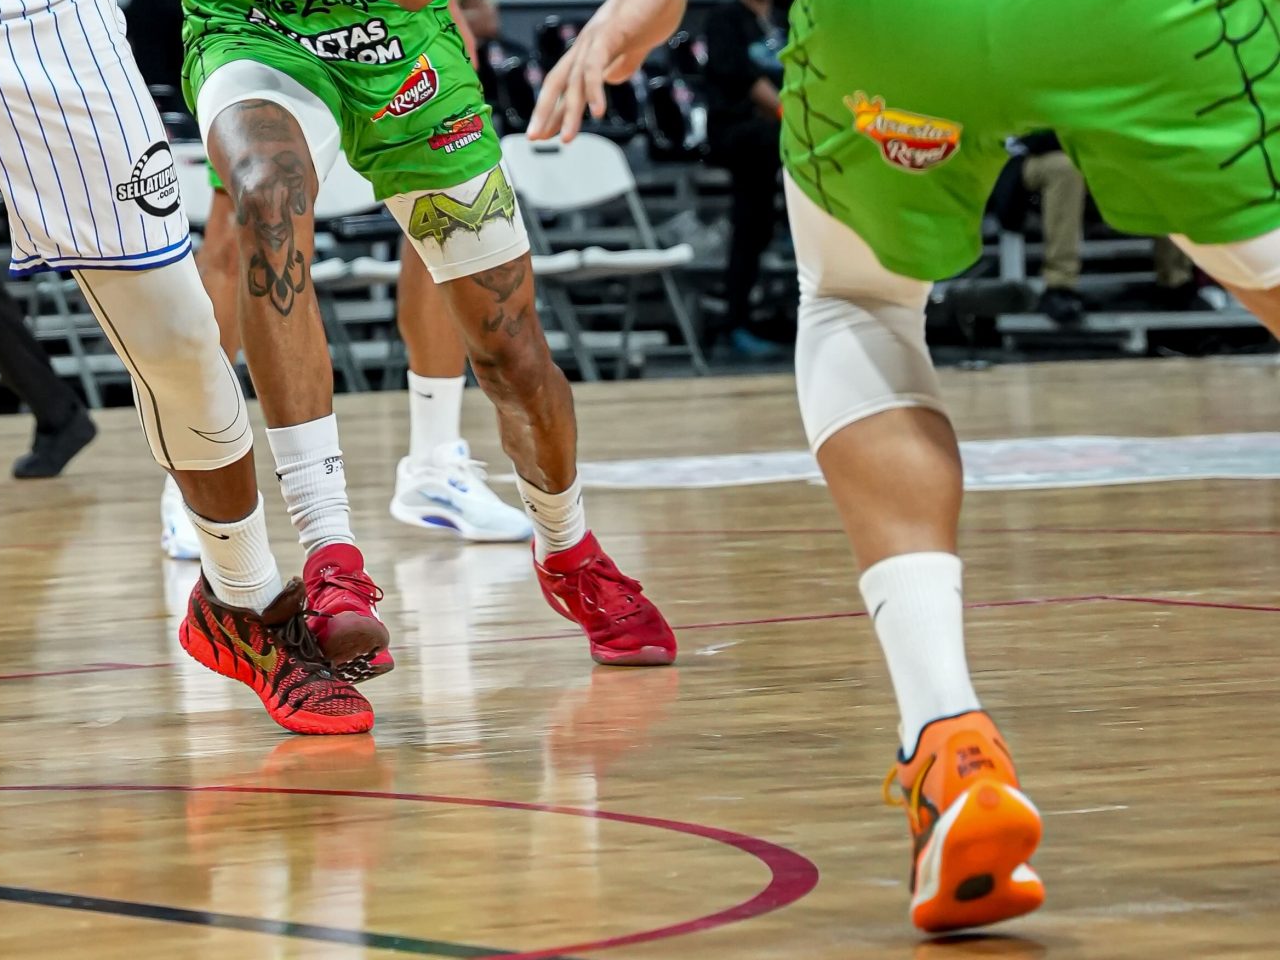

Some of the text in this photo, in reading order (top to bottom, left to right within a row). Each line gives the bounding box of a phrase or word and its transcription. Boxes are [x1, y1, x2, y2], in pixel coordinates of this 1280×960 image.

[390, 71, 430, 113] Royal
[117, 164, 178, 201] SELLATUPA
[157, 186, 175, 200] .com
